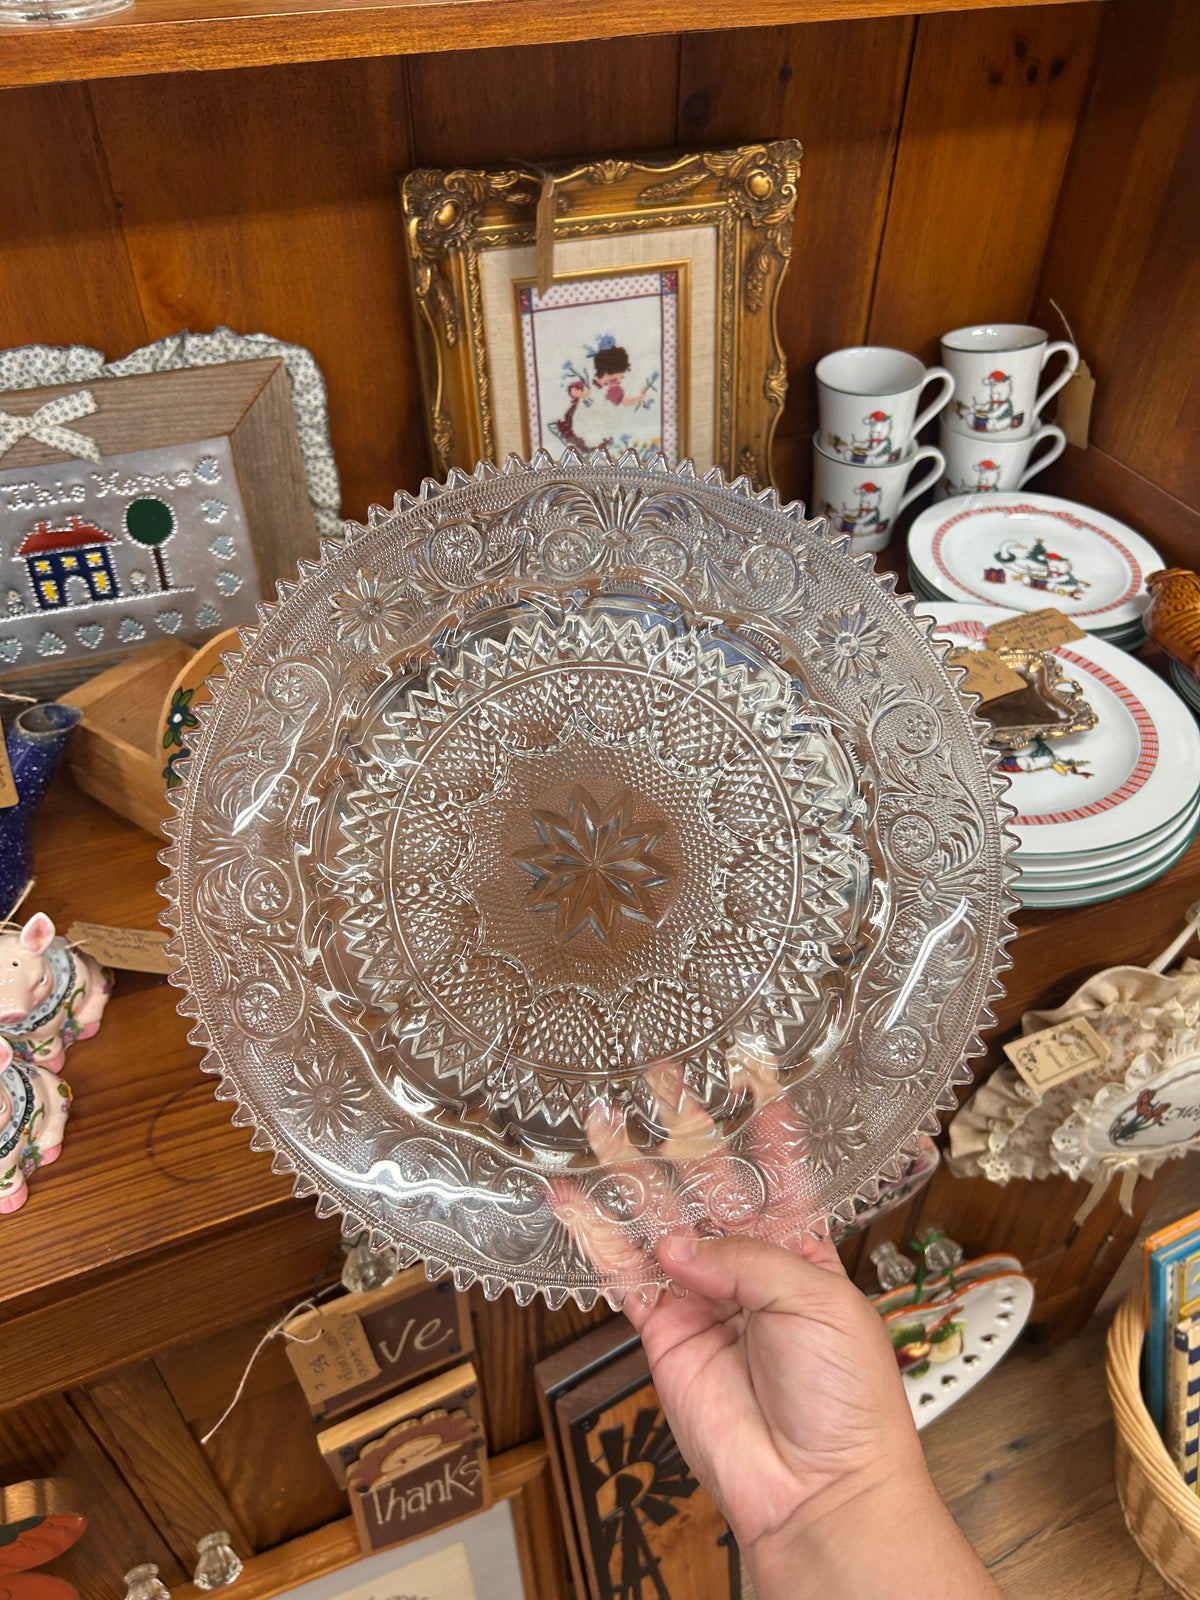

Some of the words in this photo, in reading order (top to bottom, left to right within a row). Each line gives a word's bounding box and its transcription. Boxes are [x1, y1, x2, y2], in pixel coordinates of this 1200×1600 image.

[0, 480, 86, 510] This
[90, 470, 192, 498] Home
[378, 1318, 454, 1364] ve
